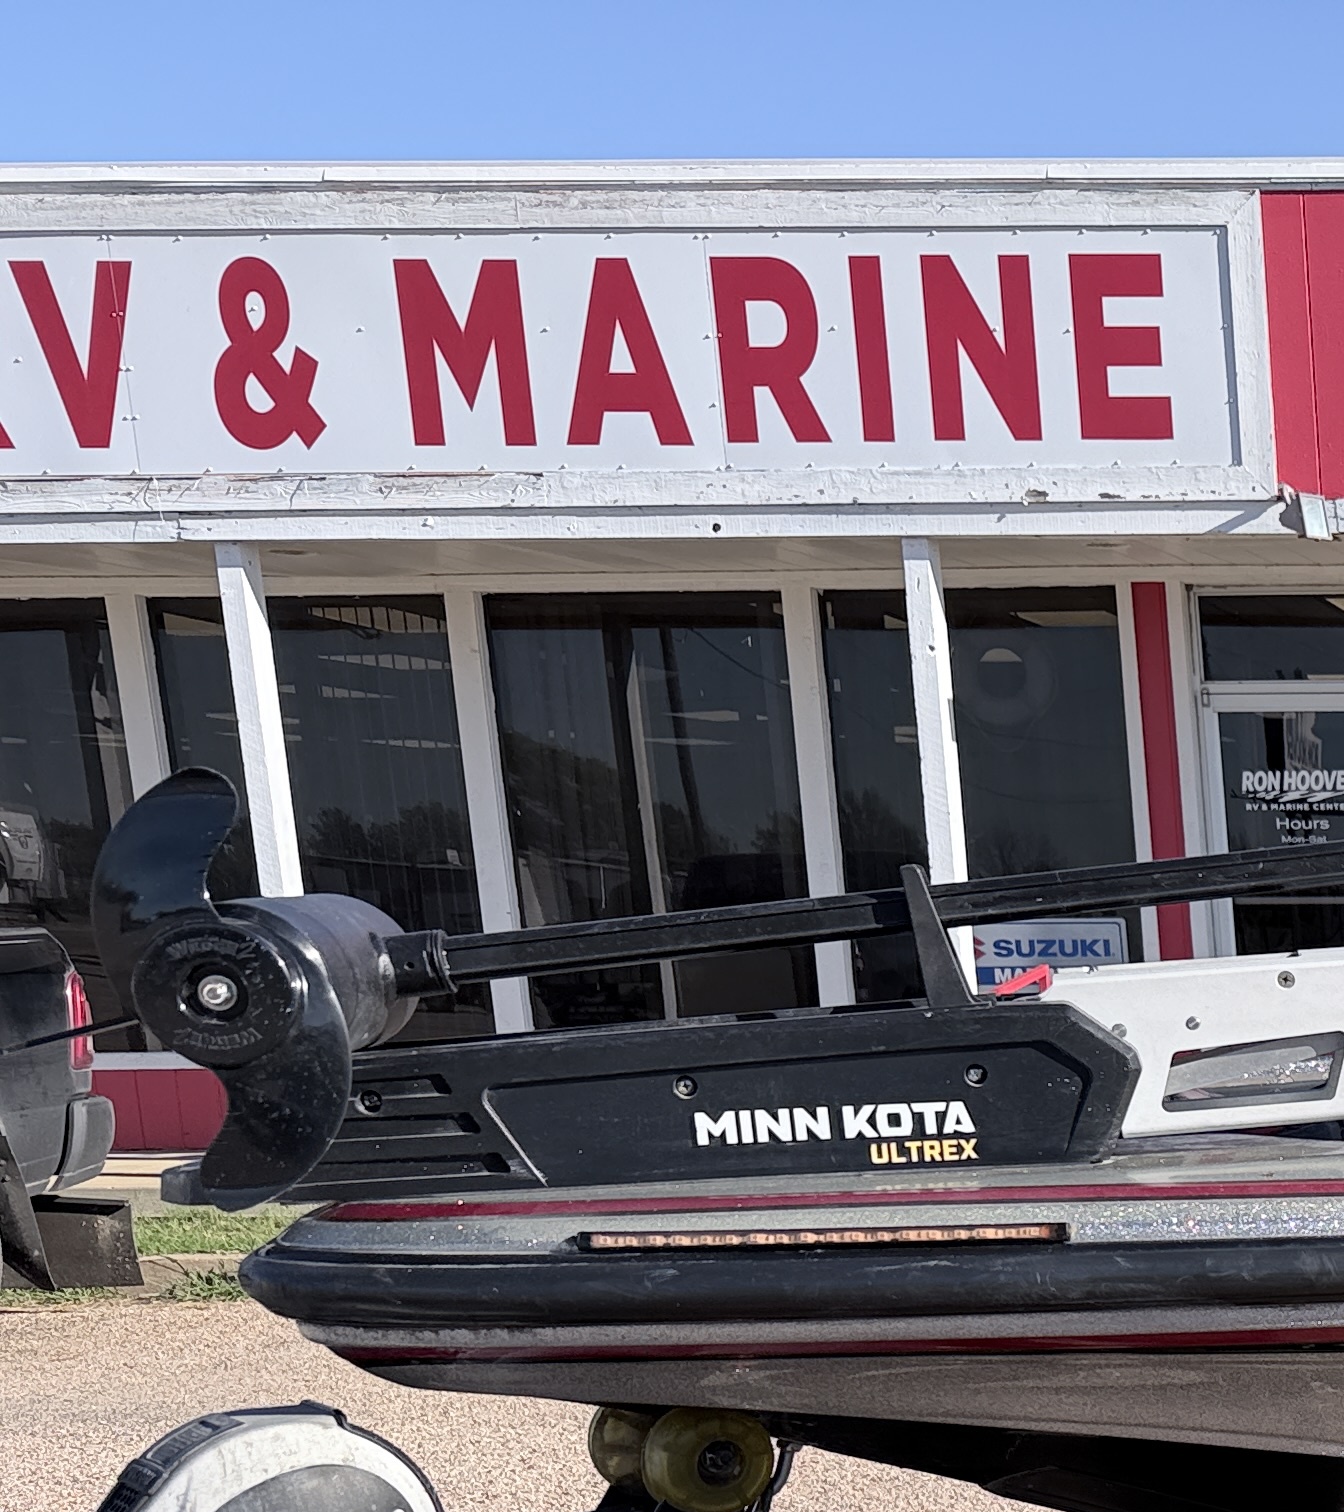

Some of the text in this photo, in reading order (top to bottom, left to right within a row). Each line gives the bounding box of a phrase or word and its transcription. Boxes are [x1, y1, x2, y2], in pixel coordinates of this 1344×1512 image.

[0, 252, 1175, 450] V & MARINE
[1241, 770, 1281, 794] RON
[1246, 803, 1260, 812] RV
[1270, 803, 1310, 811] MARINE
[1275, 817, 1331, 831] Hours
[993, 938, 1111, 959] SUZUKI
[693, 1100, 977, 1147] MINN KOTA
[869, 1138, 980, 1165] ULTREX
